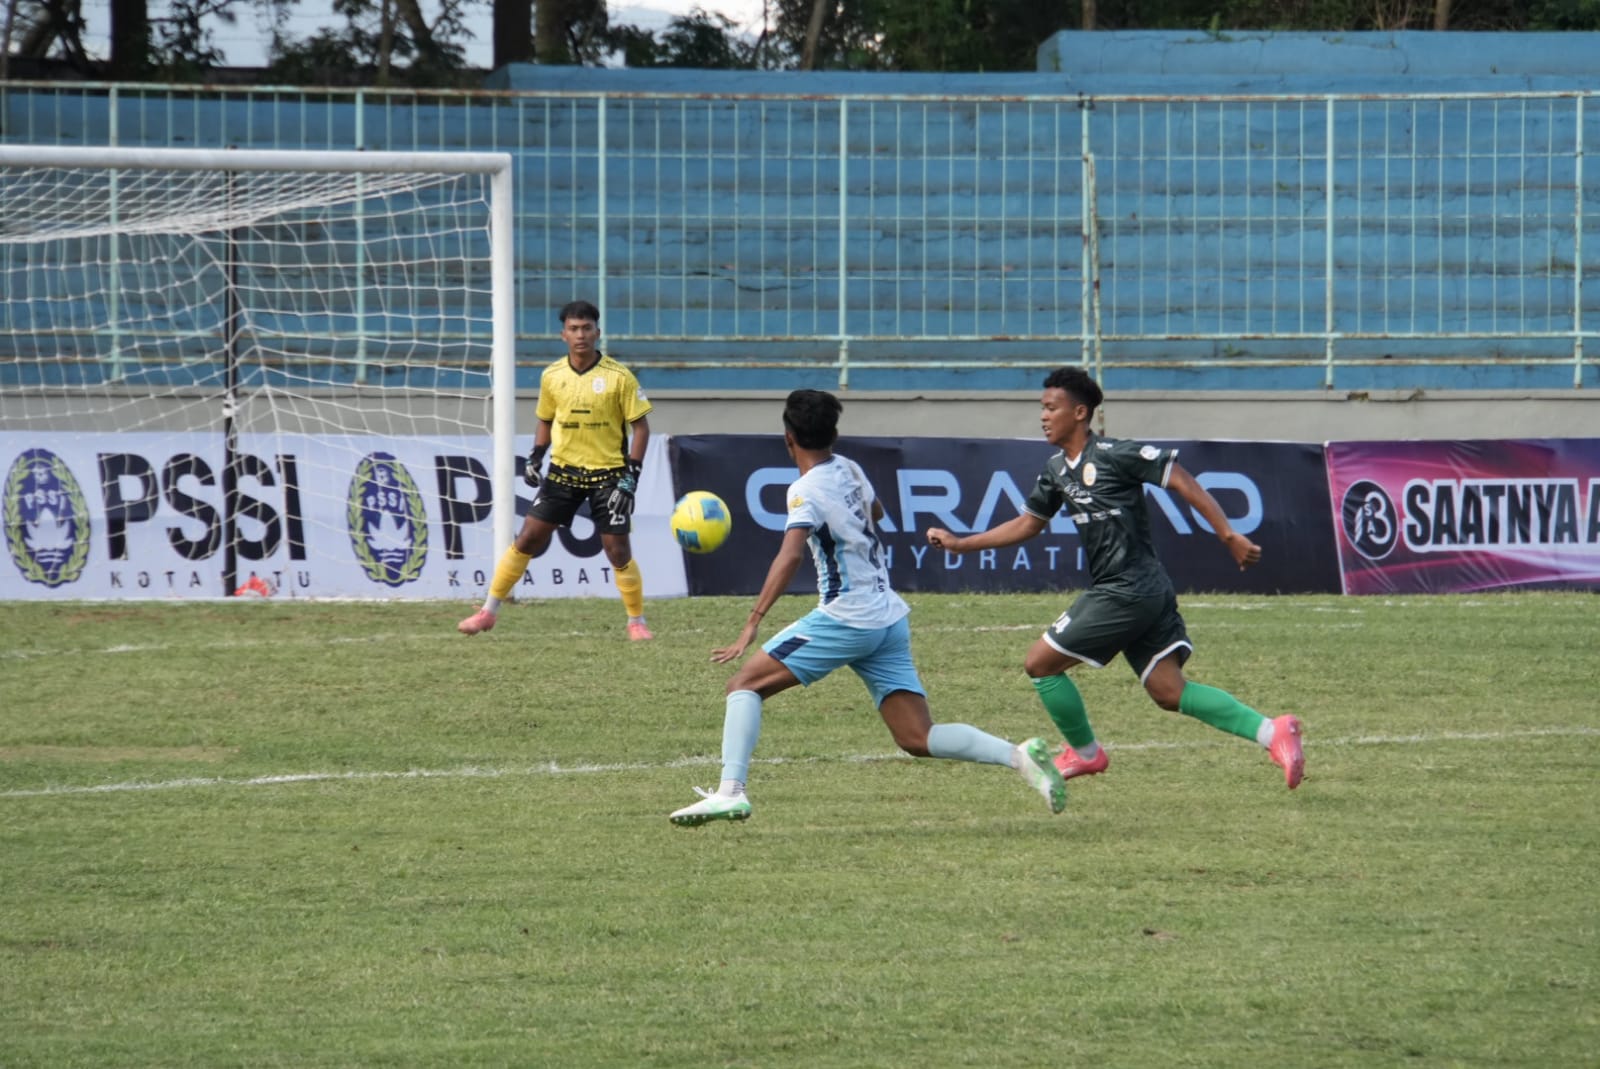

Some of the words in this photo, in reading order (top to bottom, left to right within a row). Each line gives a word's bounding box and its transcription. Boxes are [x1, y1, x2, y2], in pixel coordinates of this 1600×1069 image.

[24, 488, 67, 509] PSSI
[97, 452, 306, 561] PSSI
[1404, 480, 1580, 549] SAATNYA
[110, 570, 202, 588] KOTA
[448, 570, 535, 586] KOA
[552, 568, 618, 584] BAT
